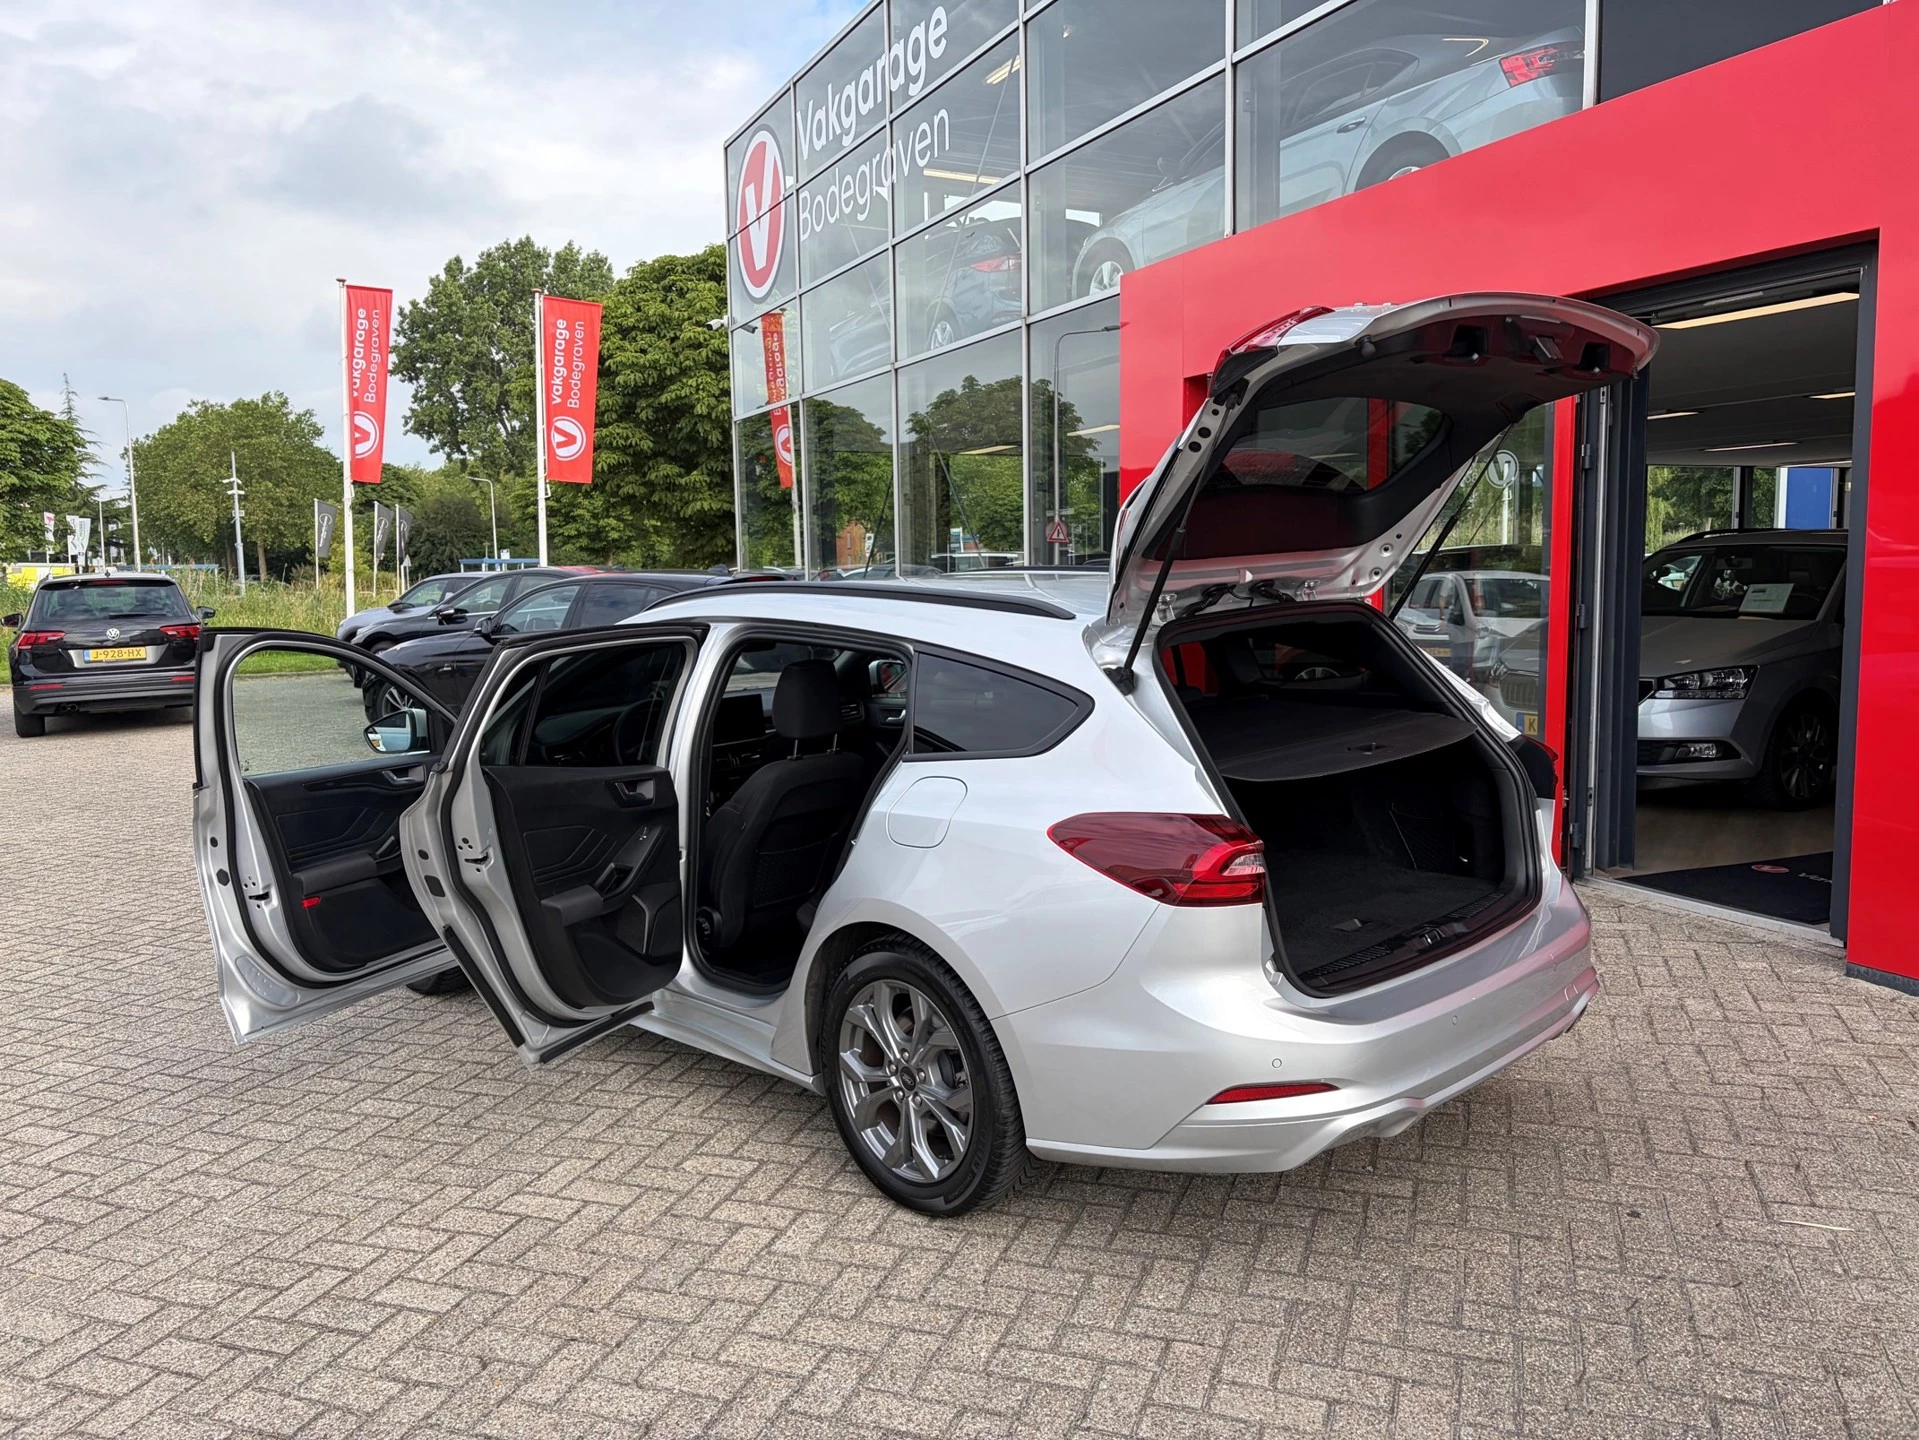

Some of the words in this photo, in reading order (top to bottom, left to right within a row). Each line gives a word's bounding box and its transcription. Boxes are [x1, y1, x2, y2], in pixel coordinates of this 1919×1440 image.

[797, 6, 948, 160] Vakgarage
[800, 108, 950, 243] Bodegraven
[364, 309, 381, 403] Bodegraven
[567, 321, 585, 408] Bodegraven
[94, 649, 141, 659] J-928-HX
